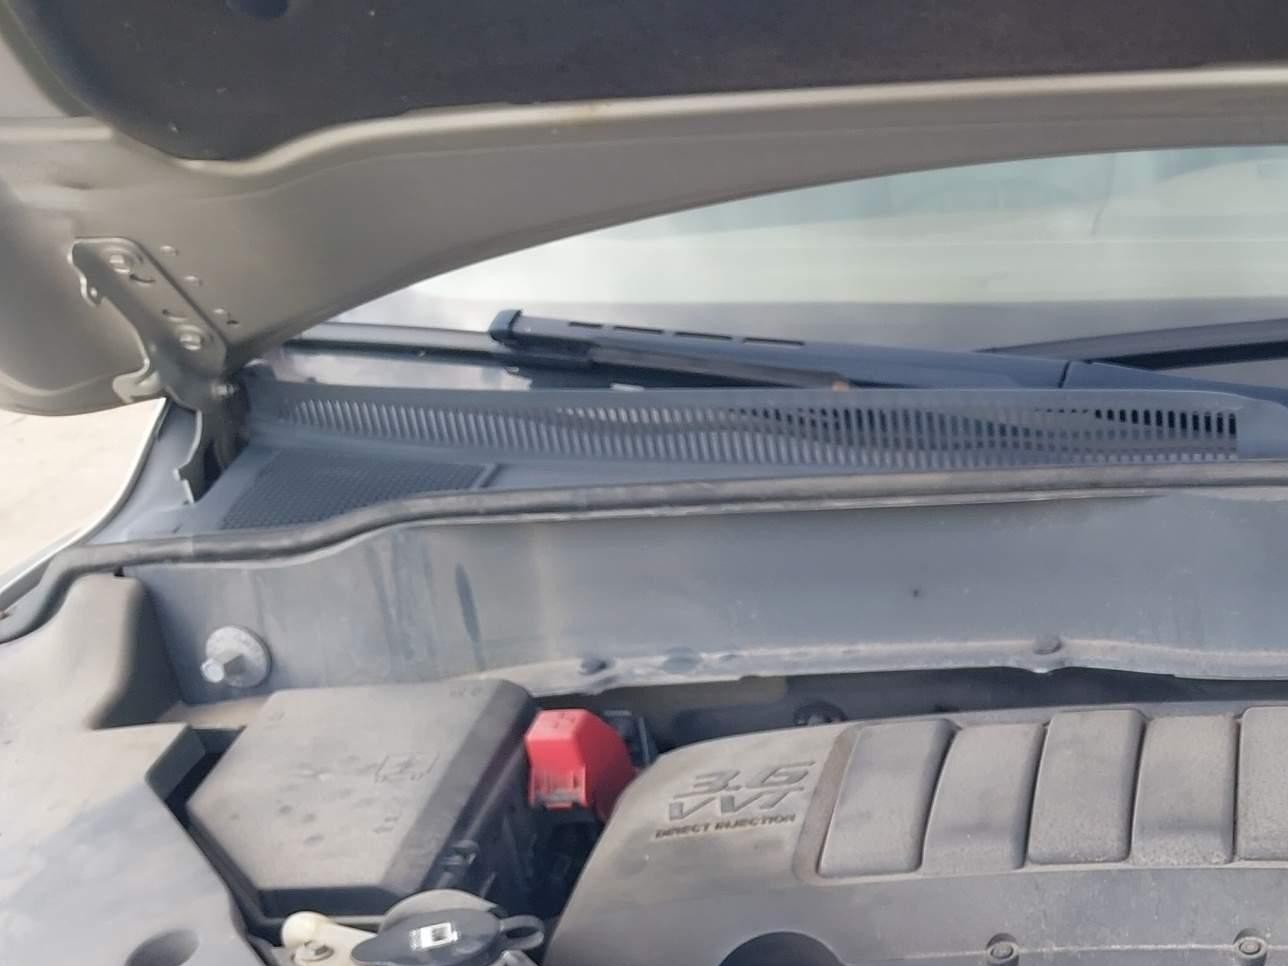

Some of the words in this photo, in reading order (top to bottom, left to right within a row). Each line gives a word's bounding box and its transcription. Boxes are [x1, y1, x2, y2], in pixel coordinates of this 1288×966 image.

[672, 760, 816, 801] 3.6
[669, 786, 806, 821] VVT
[655, 823, 711, 839] DIRECT
[714, 813, 796, 831] INJECTION
